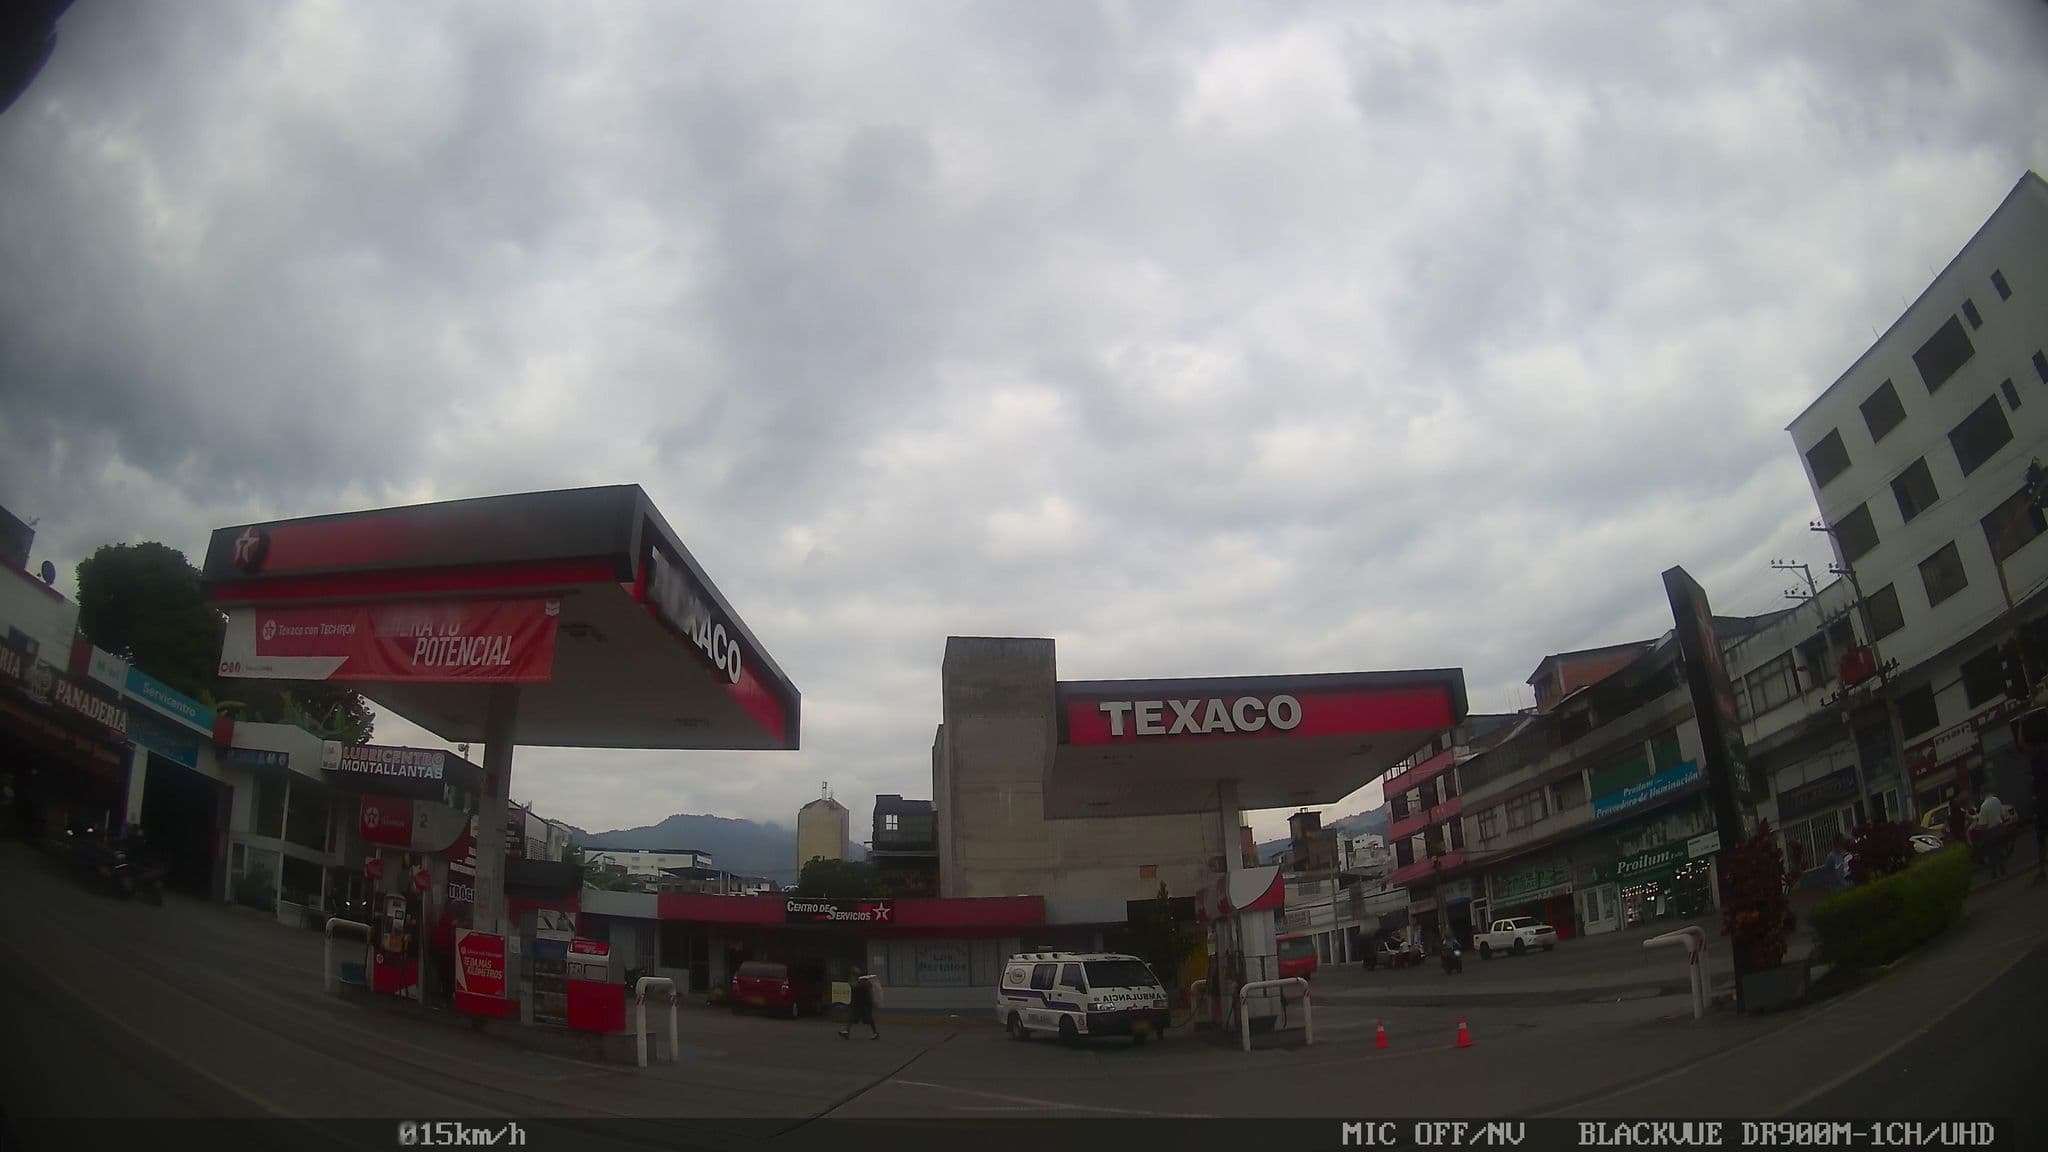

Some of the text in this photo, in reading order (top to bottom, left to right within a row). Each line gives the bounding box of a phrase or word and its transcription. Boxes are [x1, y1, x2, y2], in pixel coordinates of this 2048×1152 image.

[320, 623, 356, 637] TECHRON
[412, 635, 513, 667] POTENCIAL
[141, 680, 196, 718] Servicentro
[1099, 694, 1303, 736] TEXACO
[342, 746, 446, 767] LUBRICENTRO
[341, 759, 444, 780] MONTALLANTAS
[419, 814, 429, 829] 2
[1616, 850, 1670, 875] Proilum
[787, 900, 830, 913] CENTRO DE
[826, 906, 872, 921] SERVICIOS
